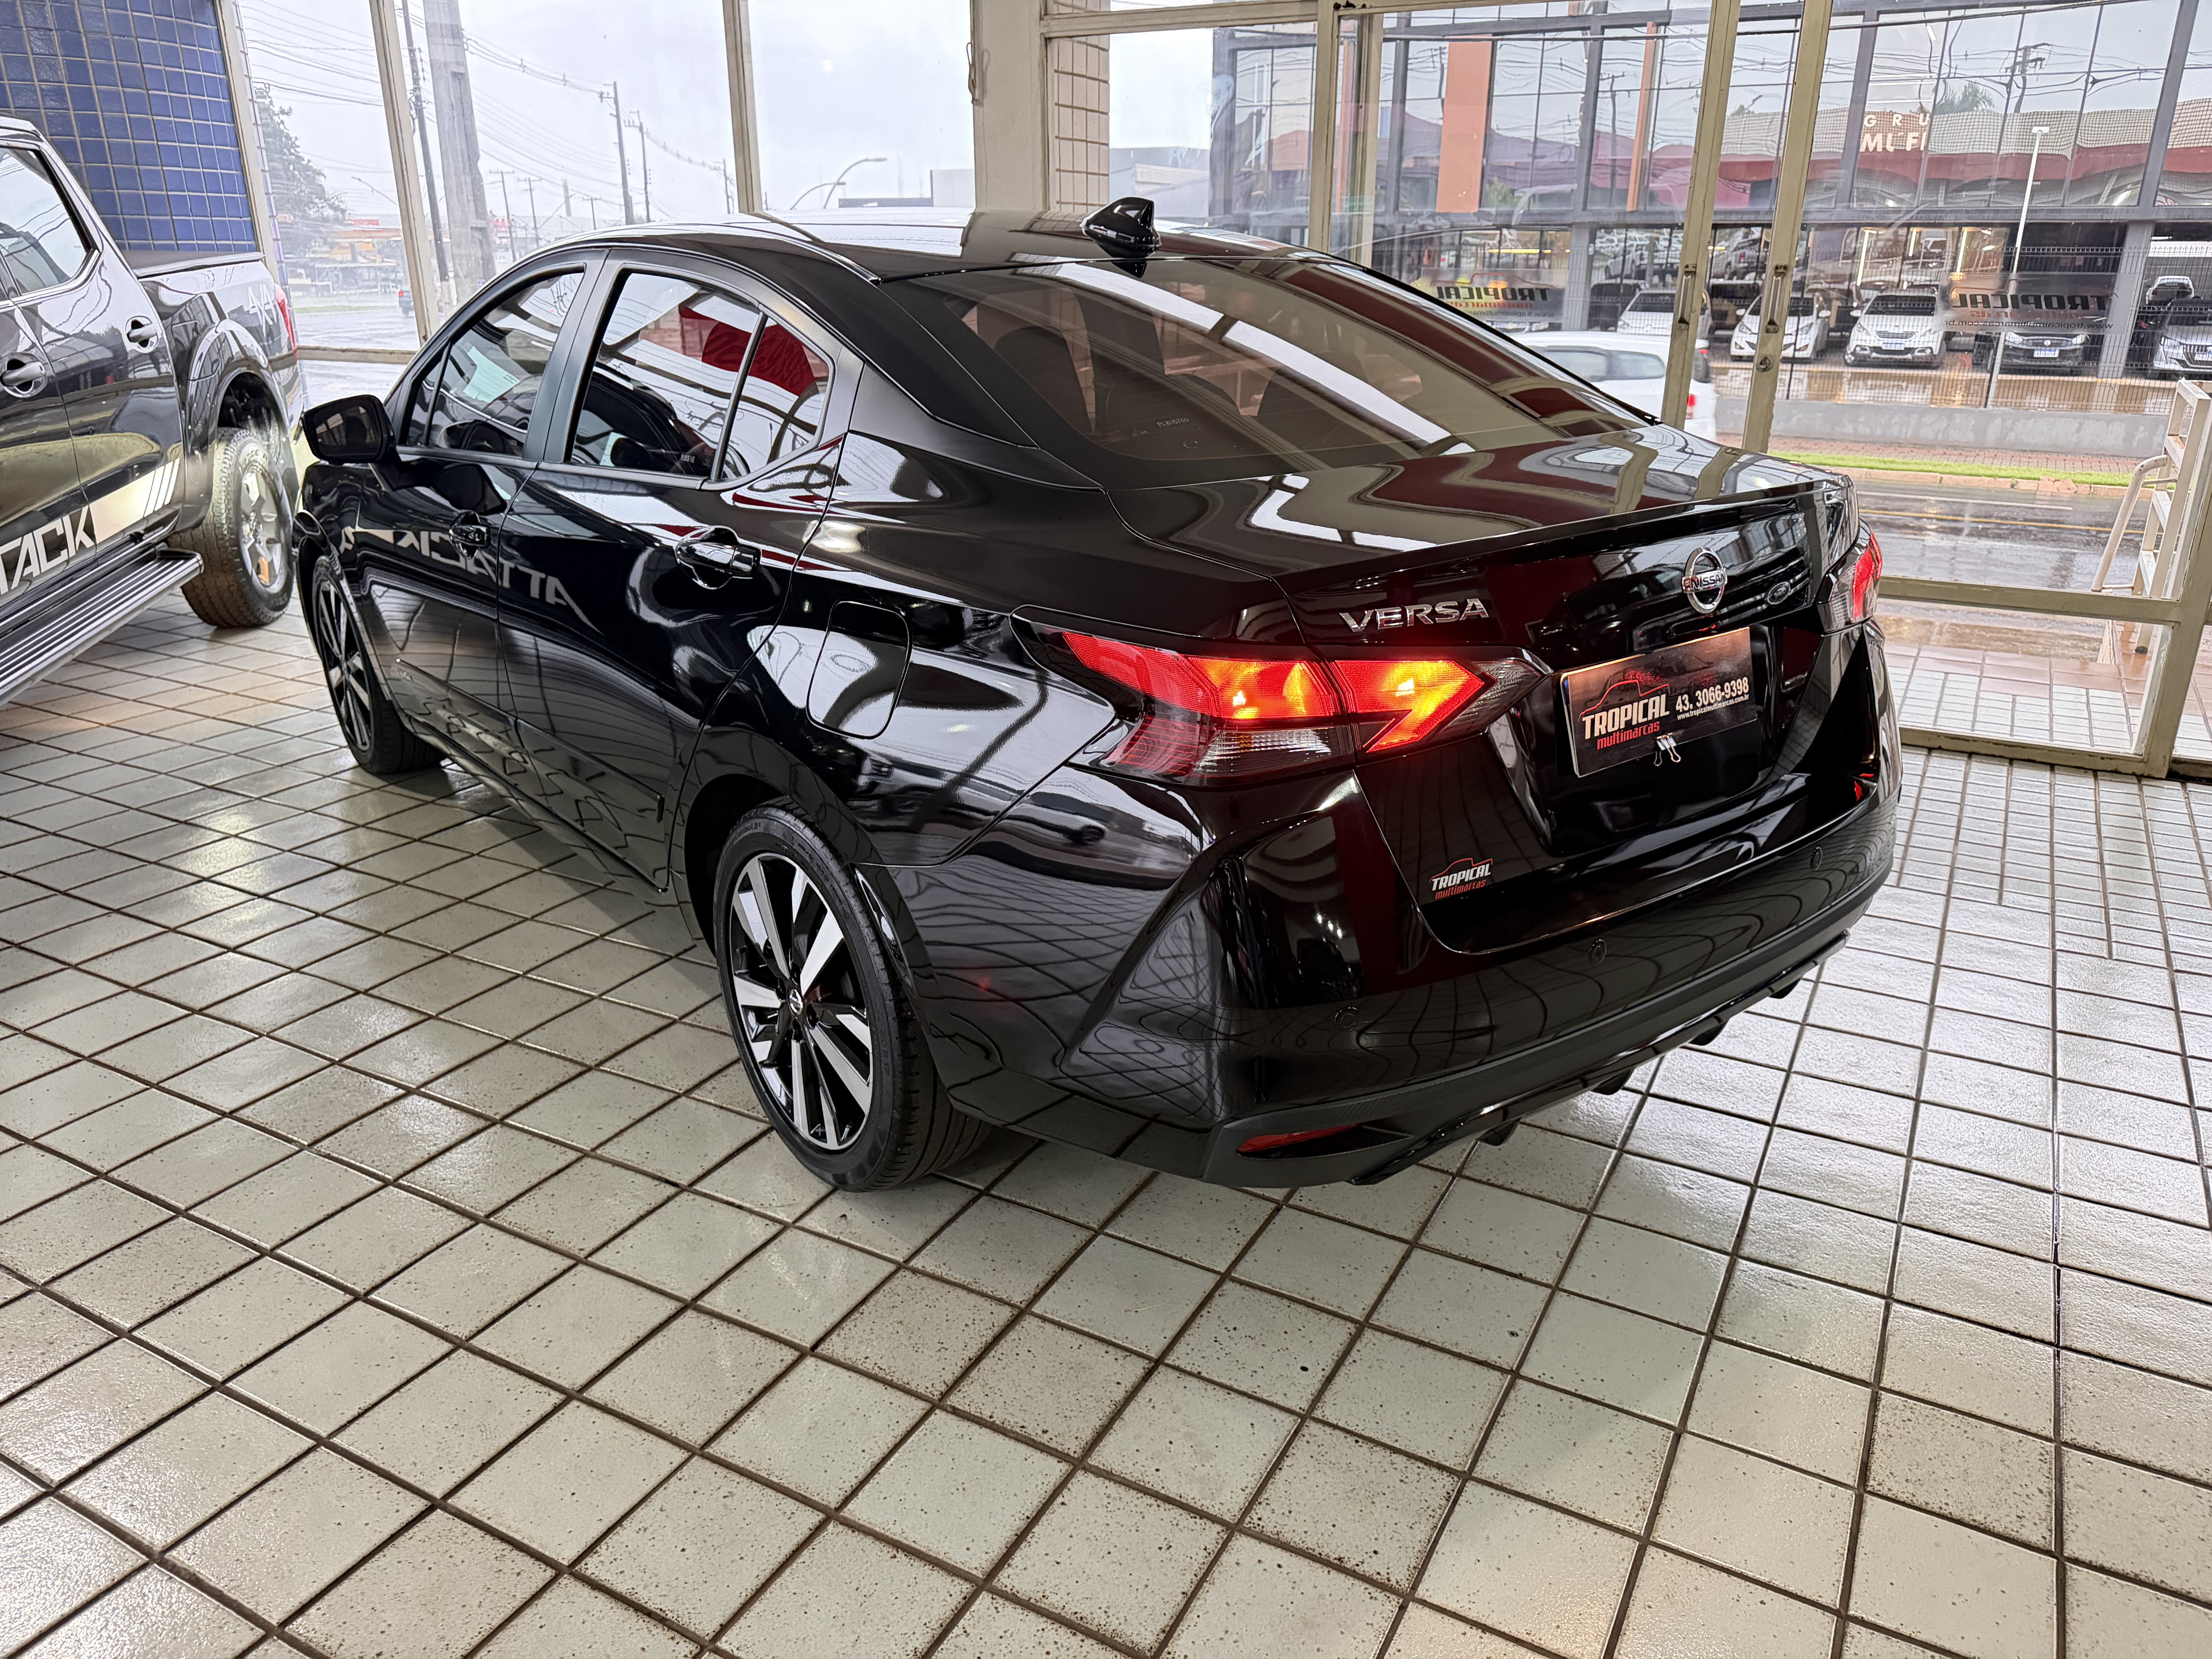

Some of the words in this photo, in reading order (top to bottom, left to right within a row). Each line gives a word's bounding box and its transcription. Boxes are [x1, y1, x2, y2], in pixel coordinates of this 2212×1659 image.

[1691, 572, 1726, 589] NISSAN
[1339, 598, 1489, 633] VERSA
[1675, 694, 1693, 713] 43.
[1695, 677, 1749, 707] 3066-9398
[1676, 694, 1750, 720] www.tropicalmultimarcas.com.br
[1582, 693, 1670, 740] TROPICAL
[1597, 721, 1661, 750] multimarcas
[1432, 863, 1491, 891] TROPICAL
[1435, 879, 1486, 900] multimarcas
